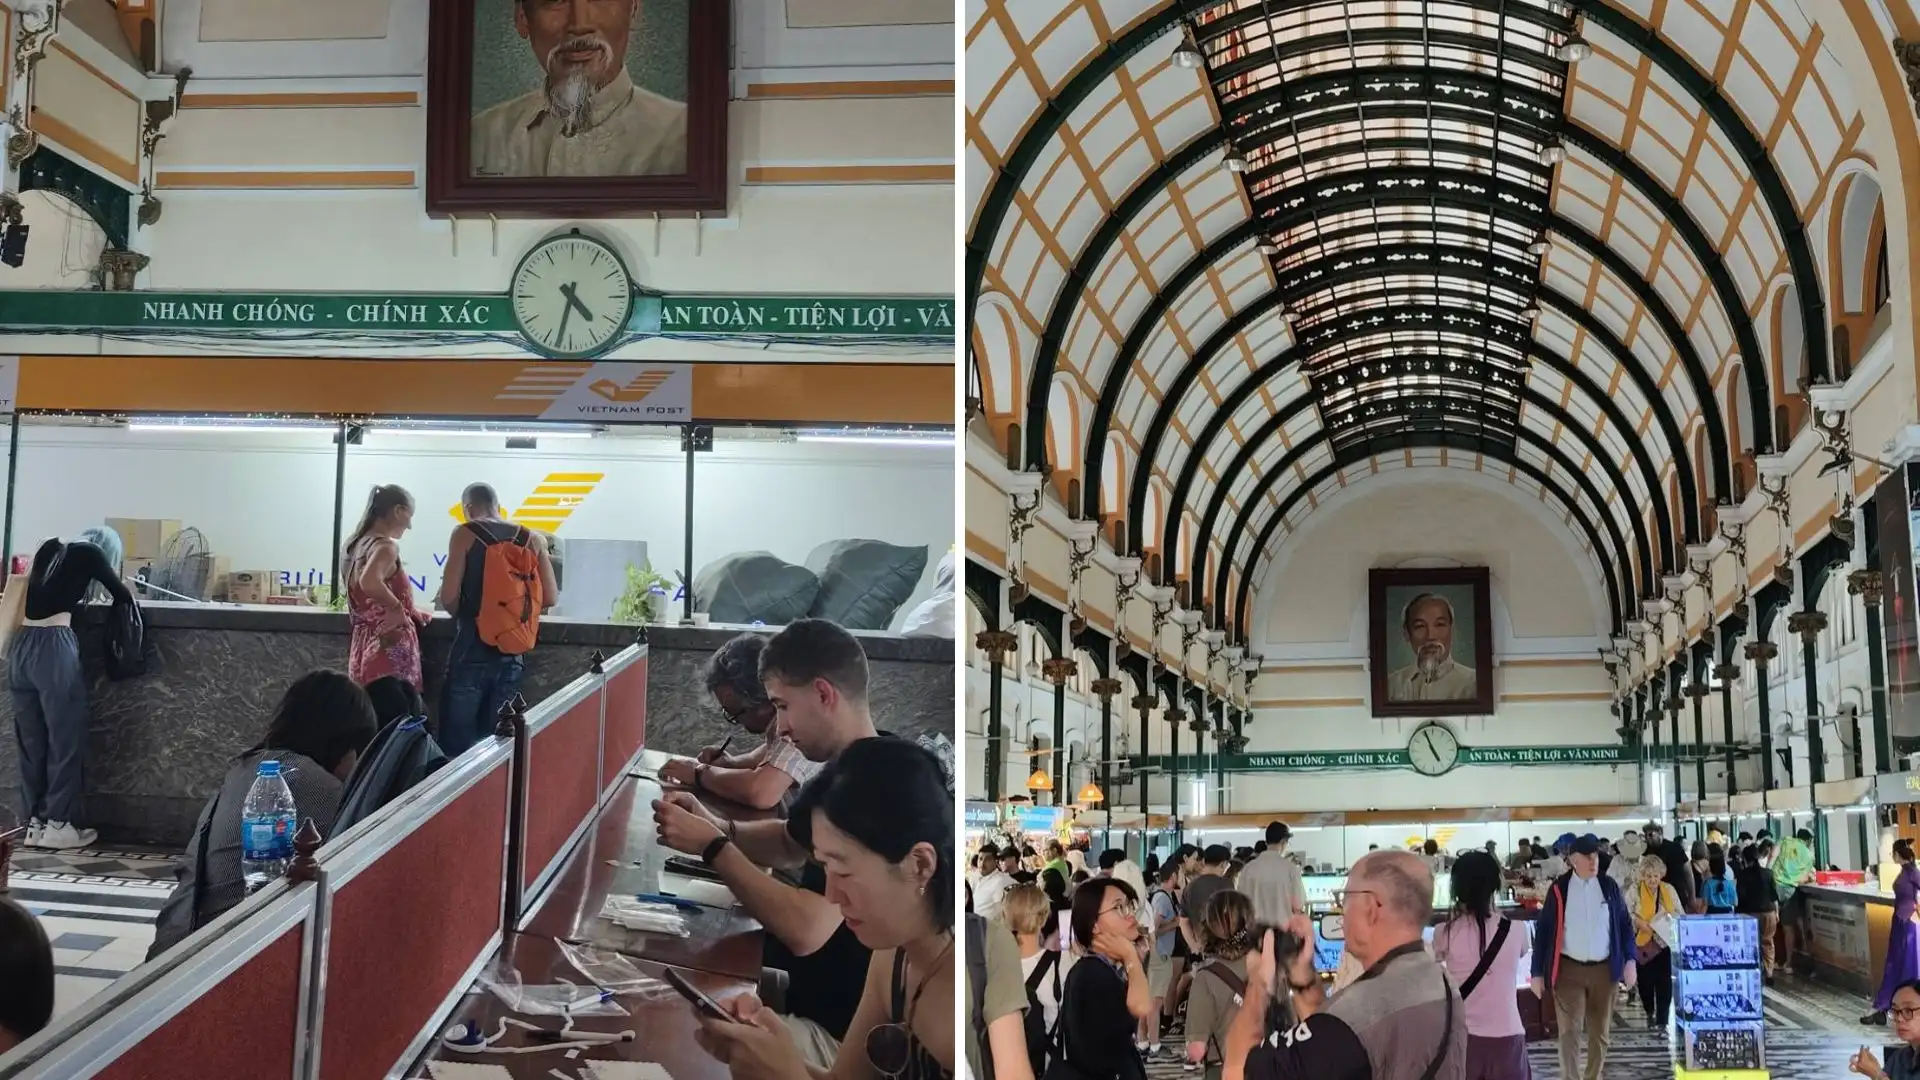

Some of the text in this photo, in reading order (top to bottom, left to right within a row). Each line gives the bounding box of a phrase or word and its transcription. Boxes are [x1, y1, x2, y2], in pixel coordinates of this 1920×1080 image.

[143, 302, 224, 320] NHANH
[232, 298, 316, 322] CHÓNG
[346, 299, 428, 323] CHÍNH
[438, 300, 490, 324] XÁC
[660, 306, 692, 325] AN
[696, 300, 765, 326] TOÀN
[783, 301, 846, 331] TIỆN
[851, 304, 896, 331] LỢI
[577, 405, 686, 415] VIETNAM POST
[1249, 756, 1286, 766] NHANH
[1288, 754, 1326, 766] CHÓNG
[1338, 753, 1374, 765] CHÍNH
[1377, 752, 1400, 764] XÁC
[1484, 749, 1511, 761] TOÀN
[1517, 749, 1542, 762] TIỆN
[1591, 749, 1619, 760] MINH
